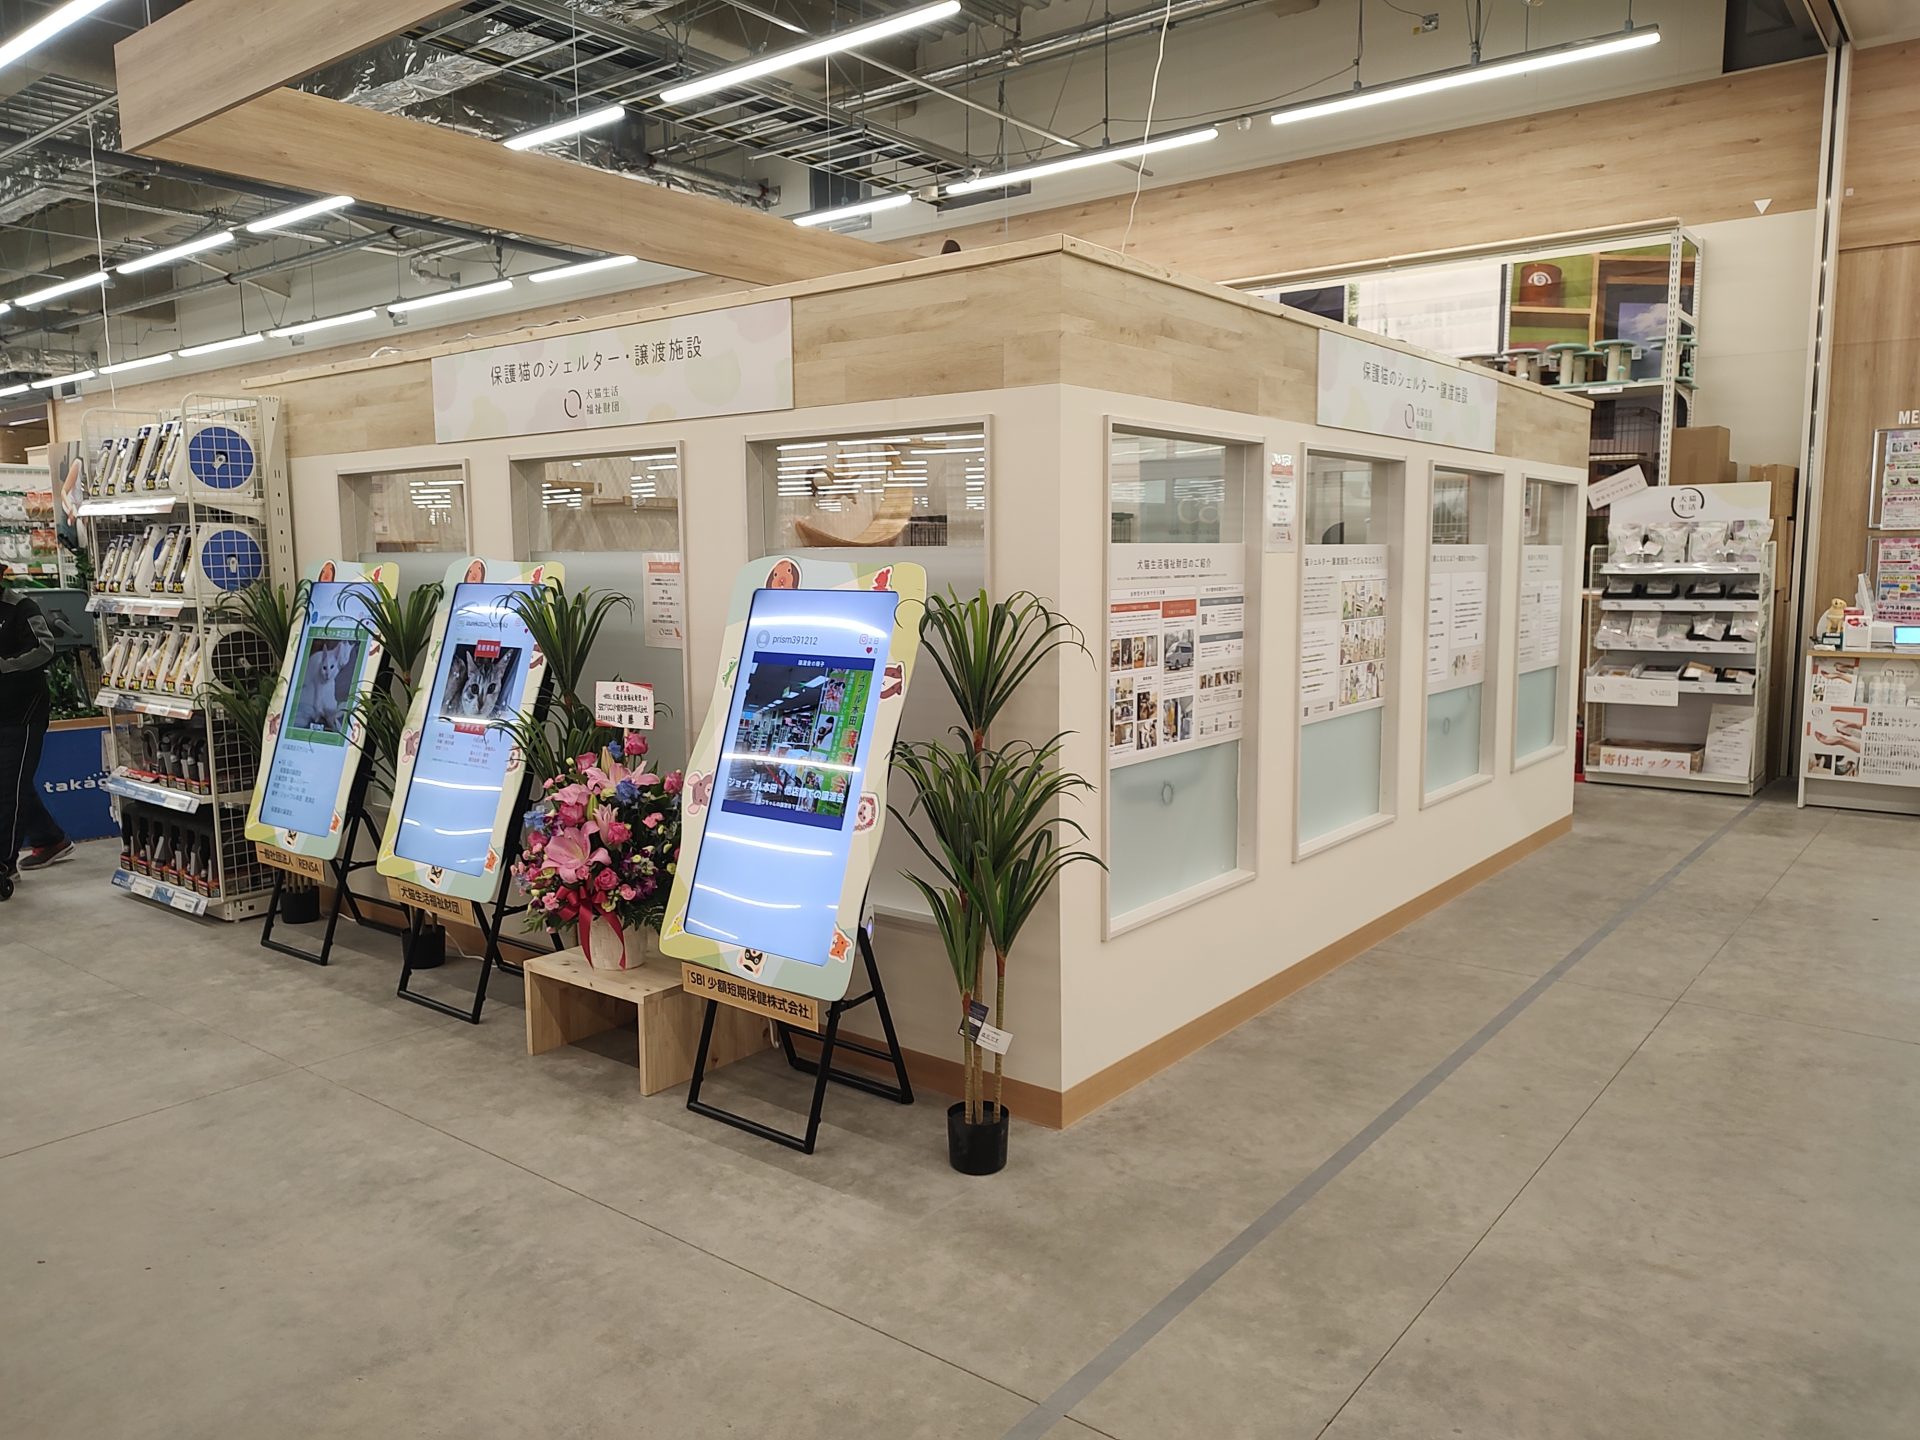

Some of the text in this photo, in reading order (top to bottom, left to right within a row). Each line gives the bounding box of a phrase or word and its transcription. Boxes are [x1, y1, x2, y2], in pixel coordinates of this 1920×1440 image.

[490, 335, 702, 386] 保護猫のシェルター・譲渡施設
[585, 385, 619, 400] 犬猫生活
[585, 401, 620, 415] 福祉財団
[772, 633, 818, 646] prism391212
[1603, 753, 1686, 770] 寄付ボックス
